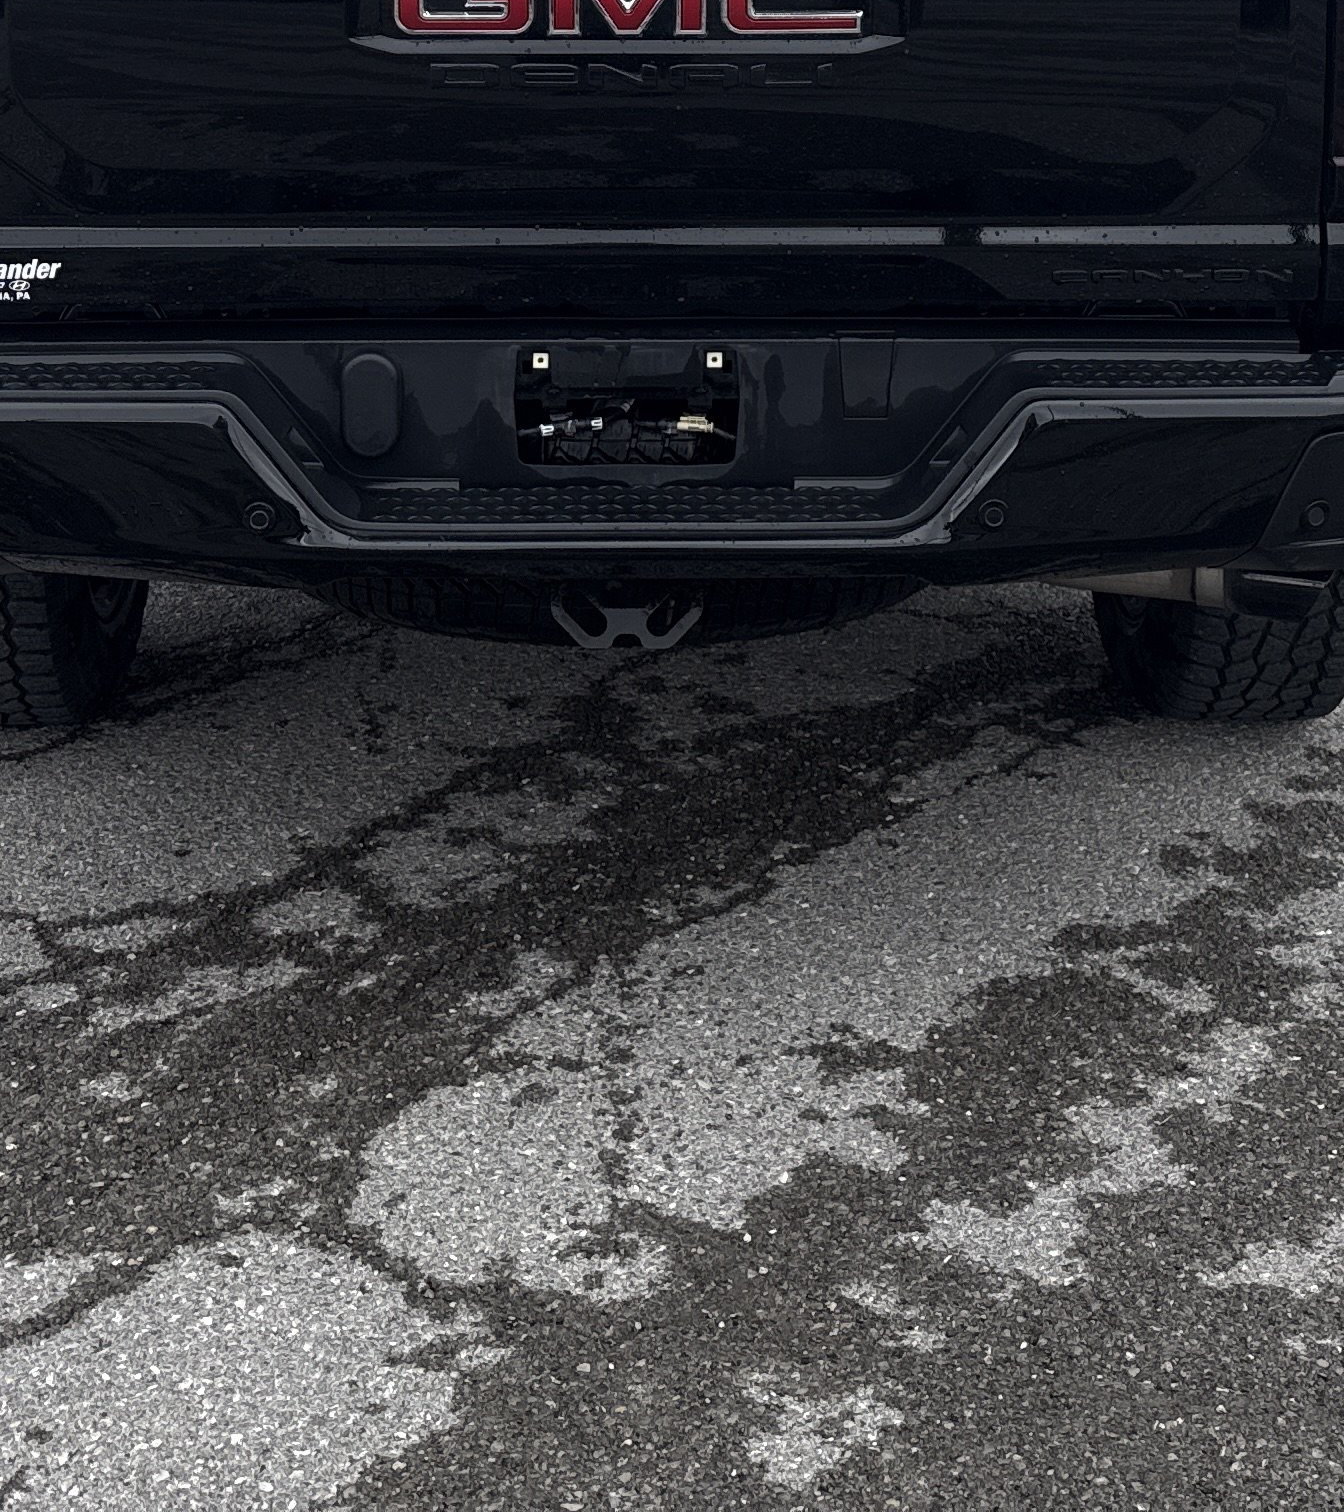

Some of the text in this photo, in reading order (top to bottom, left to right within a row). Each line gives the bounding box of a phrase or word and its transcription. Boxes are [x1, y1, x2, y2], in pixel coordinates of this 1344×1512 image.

[430, 61, 835, 88] DENALI
[1052, 268, 1294, 285] CANYON
[16, 292, 31, 300] PA
